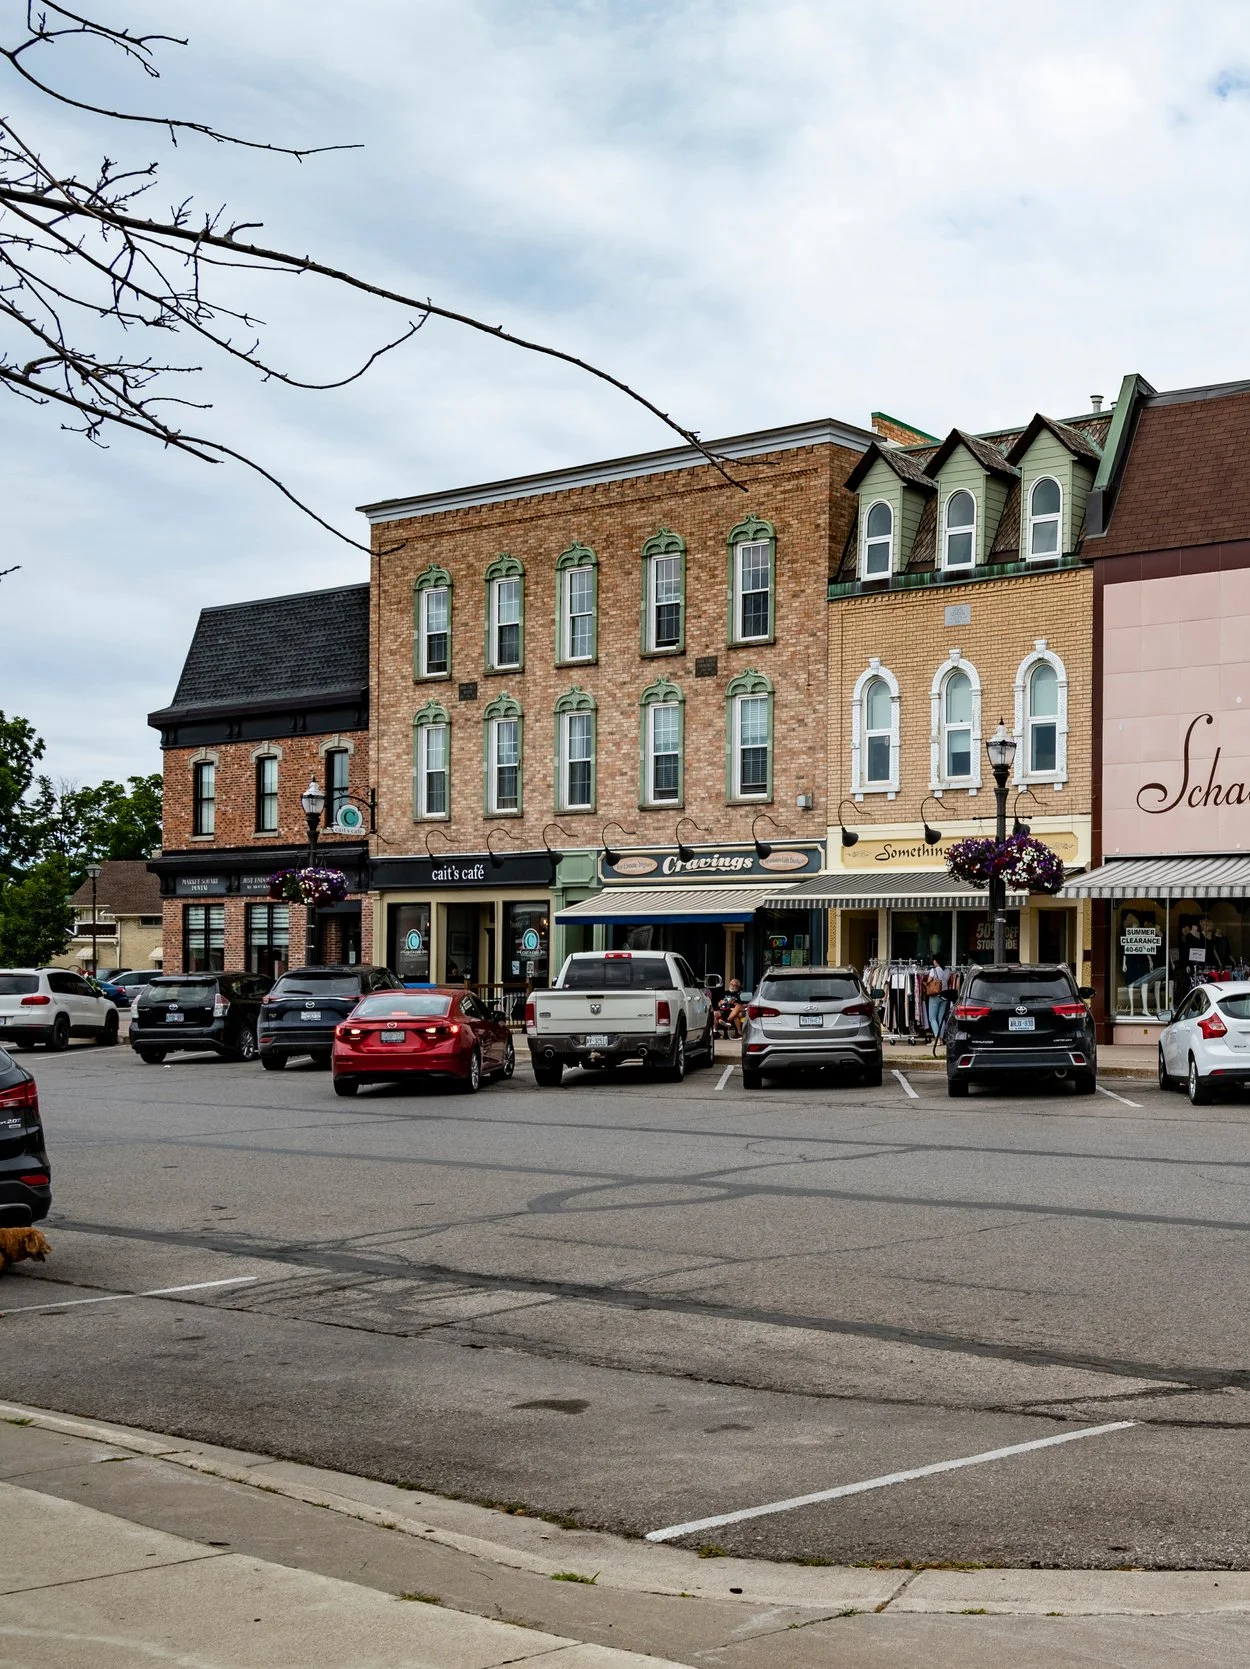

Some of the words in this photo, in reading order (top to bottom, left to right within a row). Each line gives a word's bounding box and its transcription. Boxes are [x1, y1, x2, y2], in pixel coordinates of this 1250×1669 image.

[431, 865, 460, 880] cait's
[461, 863, 485, 880] café
[662, 854, 754, 875] Cravings
[1121, 937, 1161, 945] CLEARANCE
